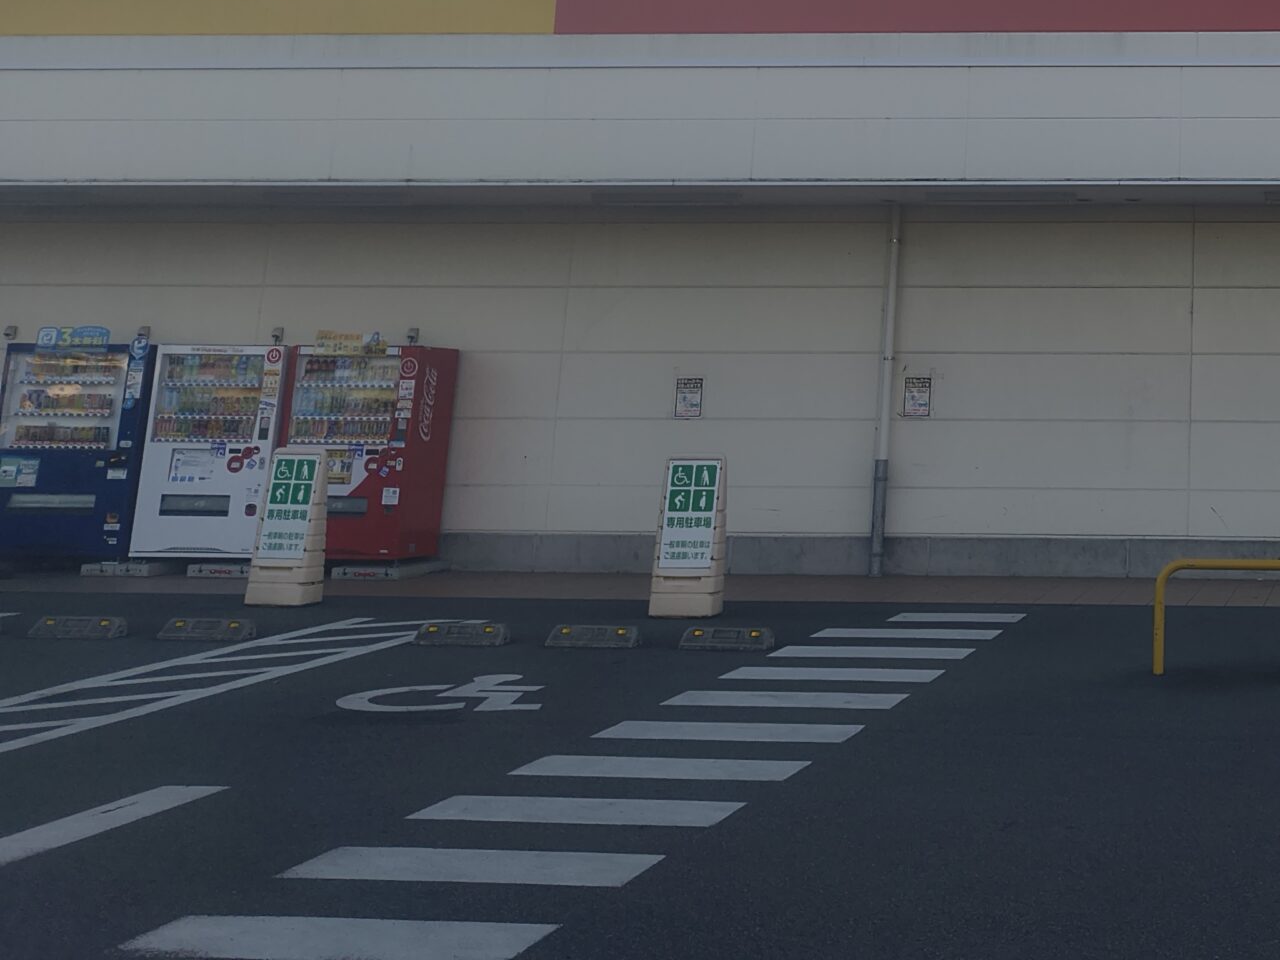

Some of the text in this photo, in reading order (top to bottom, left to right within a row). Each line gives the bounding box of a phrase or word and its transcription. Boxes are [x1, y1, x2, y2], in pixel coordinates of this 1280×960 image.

[266, 509, 309, 521] 専用駐車場
[666, 516, 712, 529] 専用駐車場
